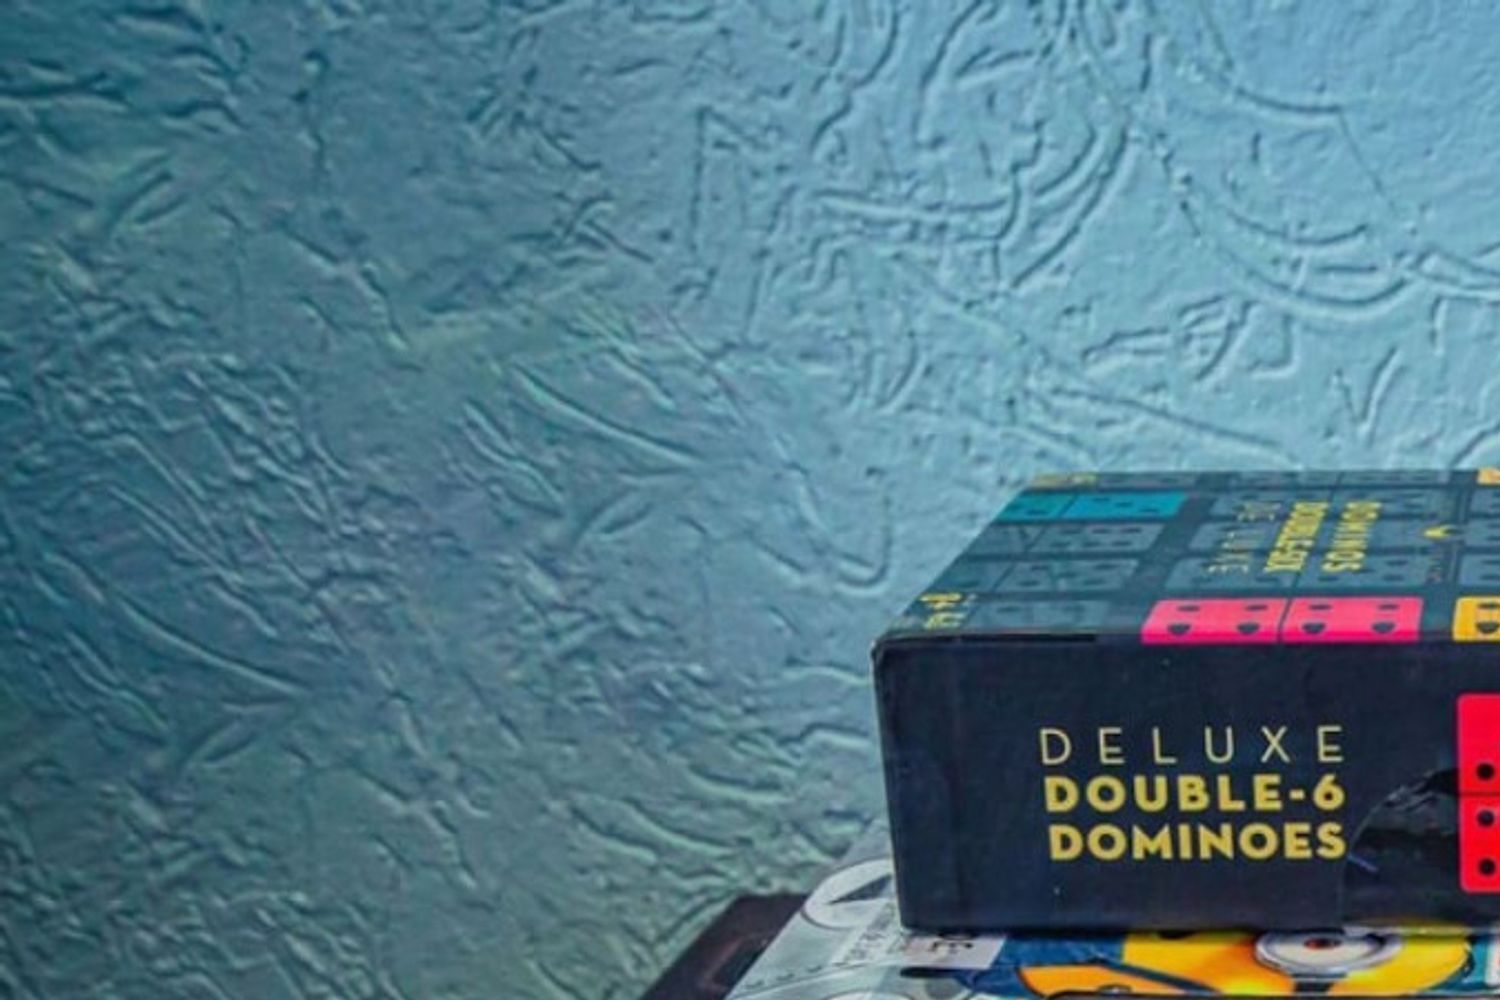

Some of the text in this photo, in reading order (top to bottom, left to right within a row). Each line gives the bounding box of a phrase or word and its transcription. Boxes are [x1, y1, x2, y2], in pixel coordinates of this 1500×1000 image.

[1039, 726, 1344, 765] DELUXE
[1044, 774, 1346, 812] DOUBLE-6
[1049, 822, 1347, 861] DOMINOES
